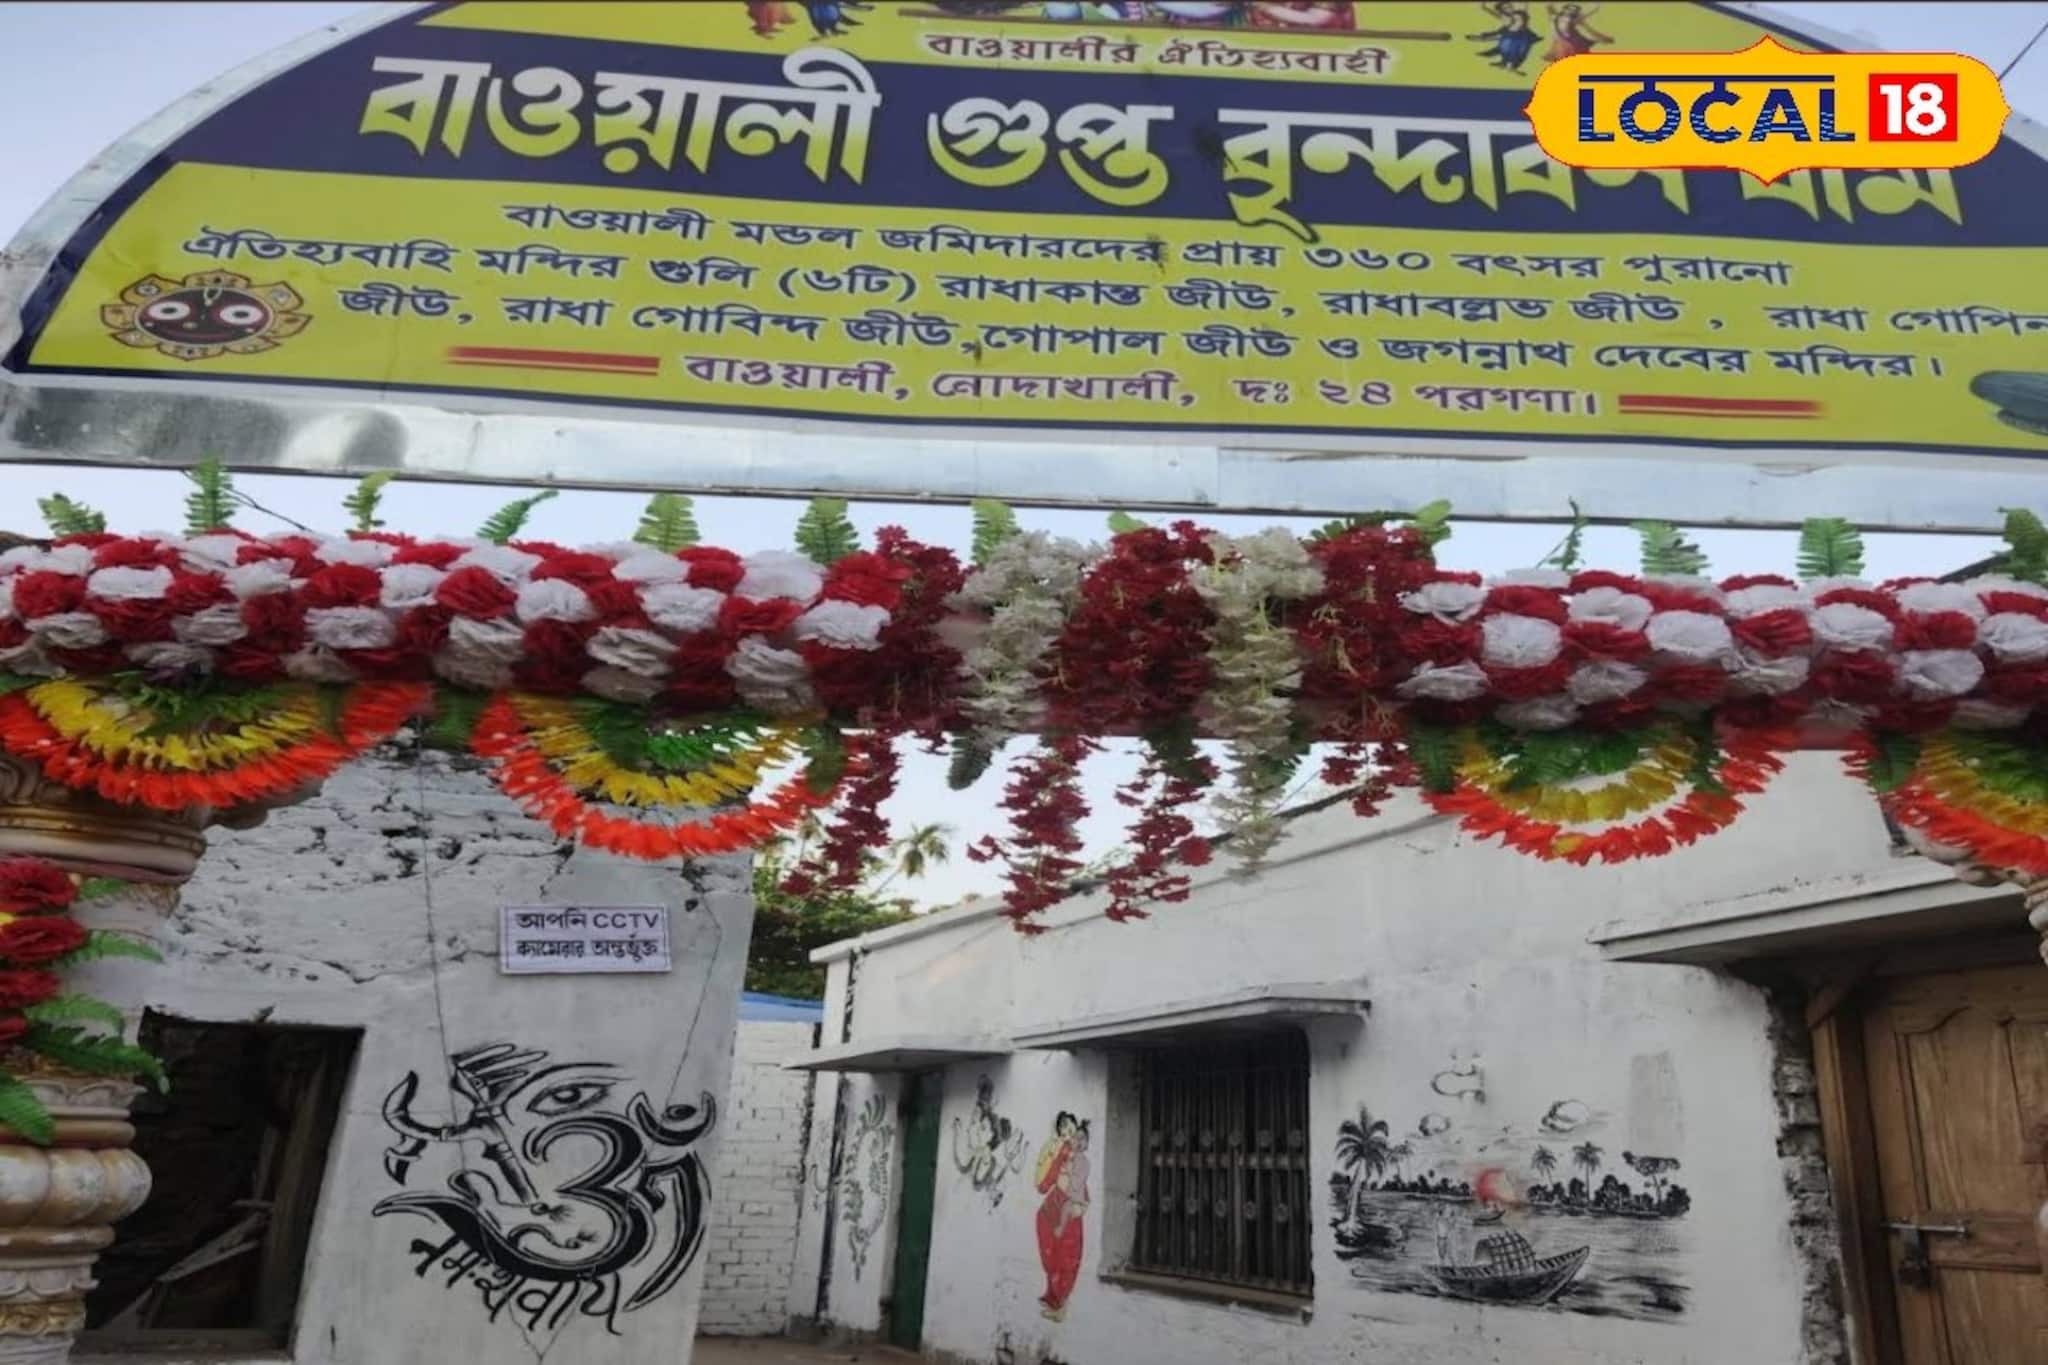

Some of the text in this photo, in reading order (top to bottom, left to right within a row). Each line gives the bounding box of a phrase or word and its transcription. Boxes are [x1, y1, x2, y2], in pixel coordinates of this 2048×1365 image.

[926, 32, 1391, 74] বাওয়ালীর ঐতিহ্যবাহী
[359, 46, 882, 186] বাওয়ালী
[927, 97, 1174, 207] গুপ্ত
[183, 226, 461, 273] ঐতিহ্যবাহি
[473, 244, 629, 279] মন্দির
[650, 256, 759, 289] গুলি
[779, 264, 917, 302] (৬টি)
[936, 274, 1150, 306] রাধাকান্ত
[1318, 290, 1554, 322] রাধাবল্লভ
[1762, 306, 1869, 332] রাধা
[502, 203, 714, 240] বাওয়ালী
[876, 224, 1166, 263] জমিদারদের
[1183, 240, 1284, 267] প্রায়
[1303, 246, 1431, 270] ৩৬০
[1451, 252, 1605, 278] বৎসর
[1624, 253, 1793, 286] পুরানো
[338, 282, 472, 325] জীউ,
[501, 297, 616, 326] রাধা
[632, 303, 829, 341] গোবিন্দ
[1182, 324, 1299, 358] জীউ
[1319, 338, 1360, 359] ও
[1379, 338, 1575, 371] জগন্নাথ
[1594, 344, 1752, 374] দেবের
[683, 356, 909, 400] বাওয়ালী,
[1318, 379, 1393, 407] ২৪
[514, 907, 660, 930] আপনি CCTV
